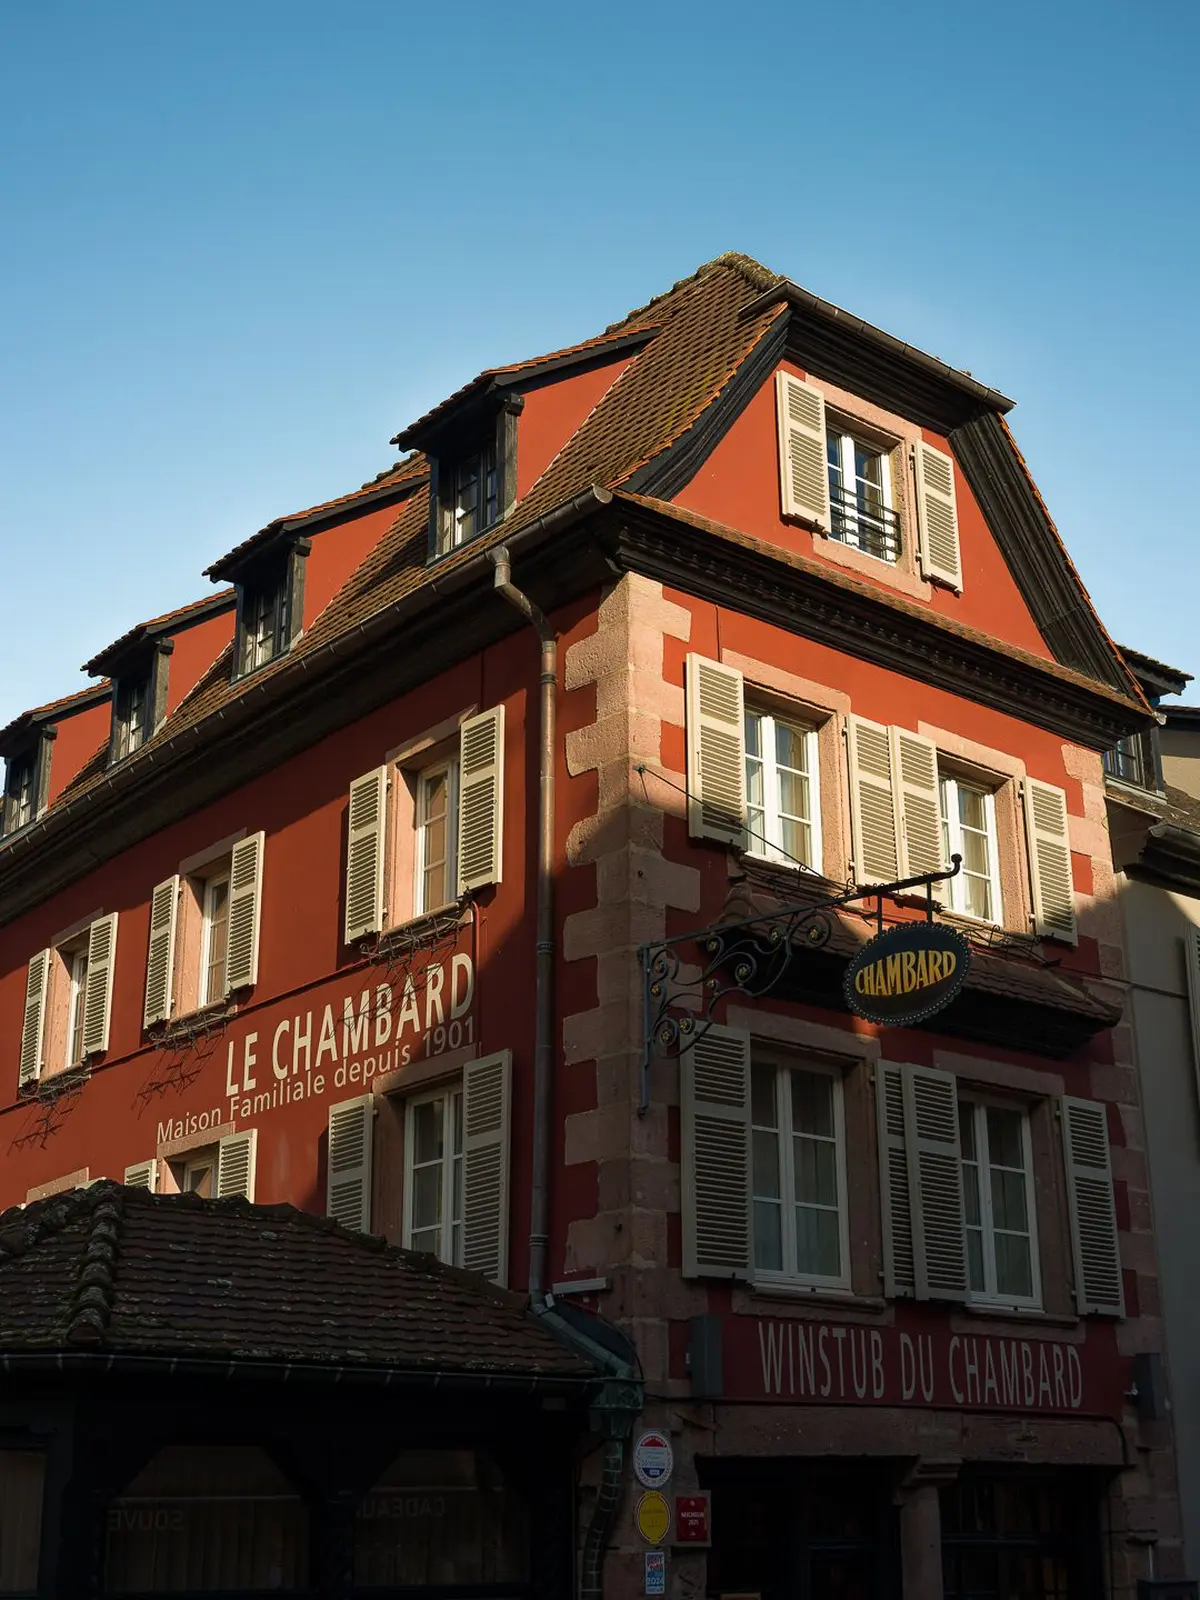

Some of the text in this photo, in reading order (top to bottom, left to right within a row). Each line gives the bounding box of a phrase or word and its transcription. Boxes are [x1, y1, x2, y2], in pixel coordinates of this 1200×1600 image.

[225, 952, 475, 1098] LE CHAMBARD
[855, 950, 957, 996] CHAMBARD
[156, 1015, 475, 1145] Maison Familiale depuis 1901
[757, 1320, 1082, 1408] WINSTUB DU CHAMBARD
